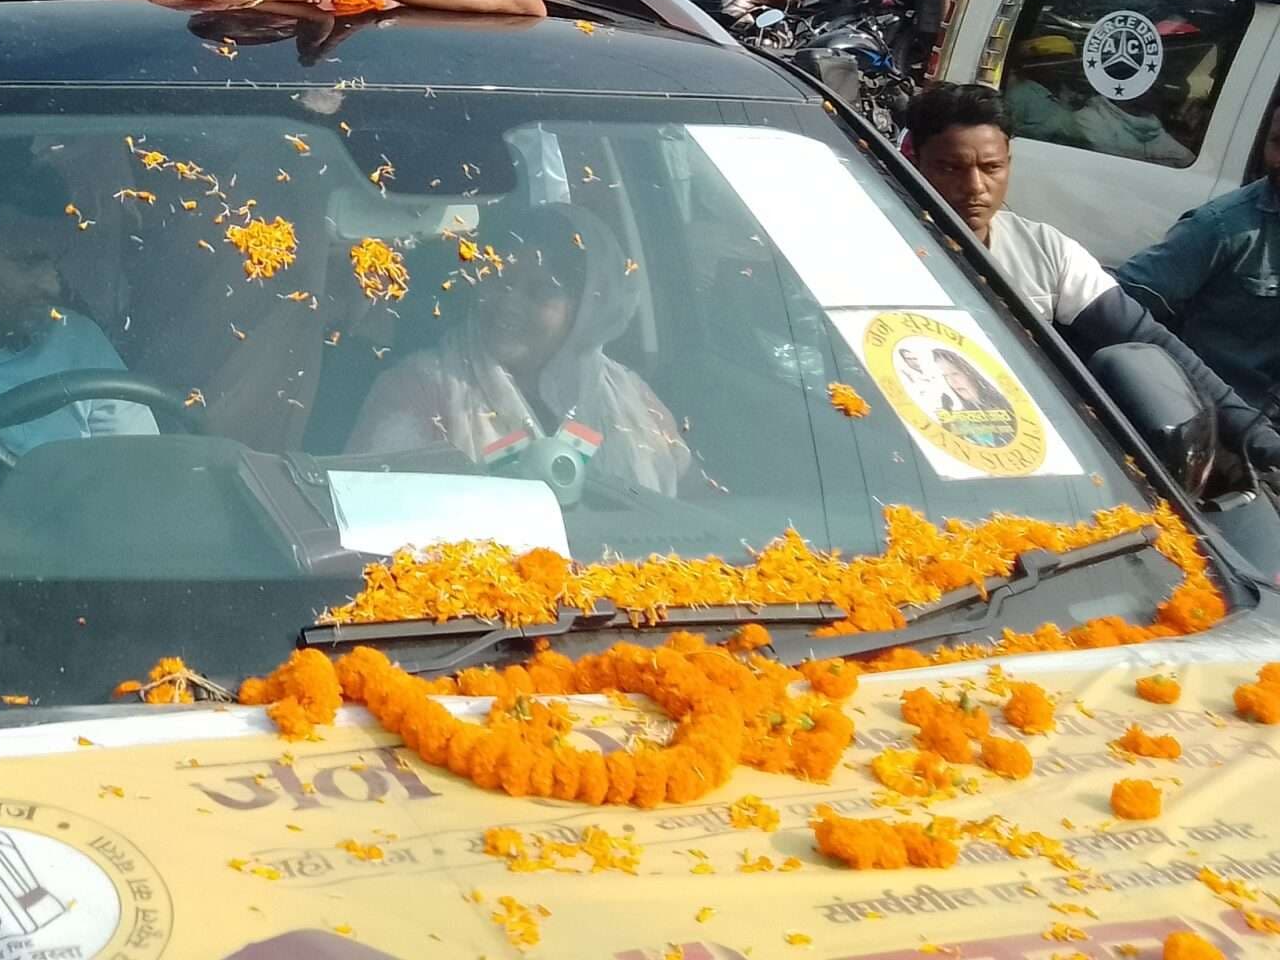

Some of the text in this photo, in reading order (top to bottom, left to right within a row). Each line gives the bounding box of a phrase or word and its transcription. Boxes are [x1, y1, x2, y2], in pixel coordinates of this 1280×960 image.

[1087, 15, 1159, 56] MERCEDES
[1103, 38, 1140, 55] A C
[84, 835, 137, 875] बस्ता
[125, 877, 154, 902] का
[816, 885, 988, 923] संघर्षशील
